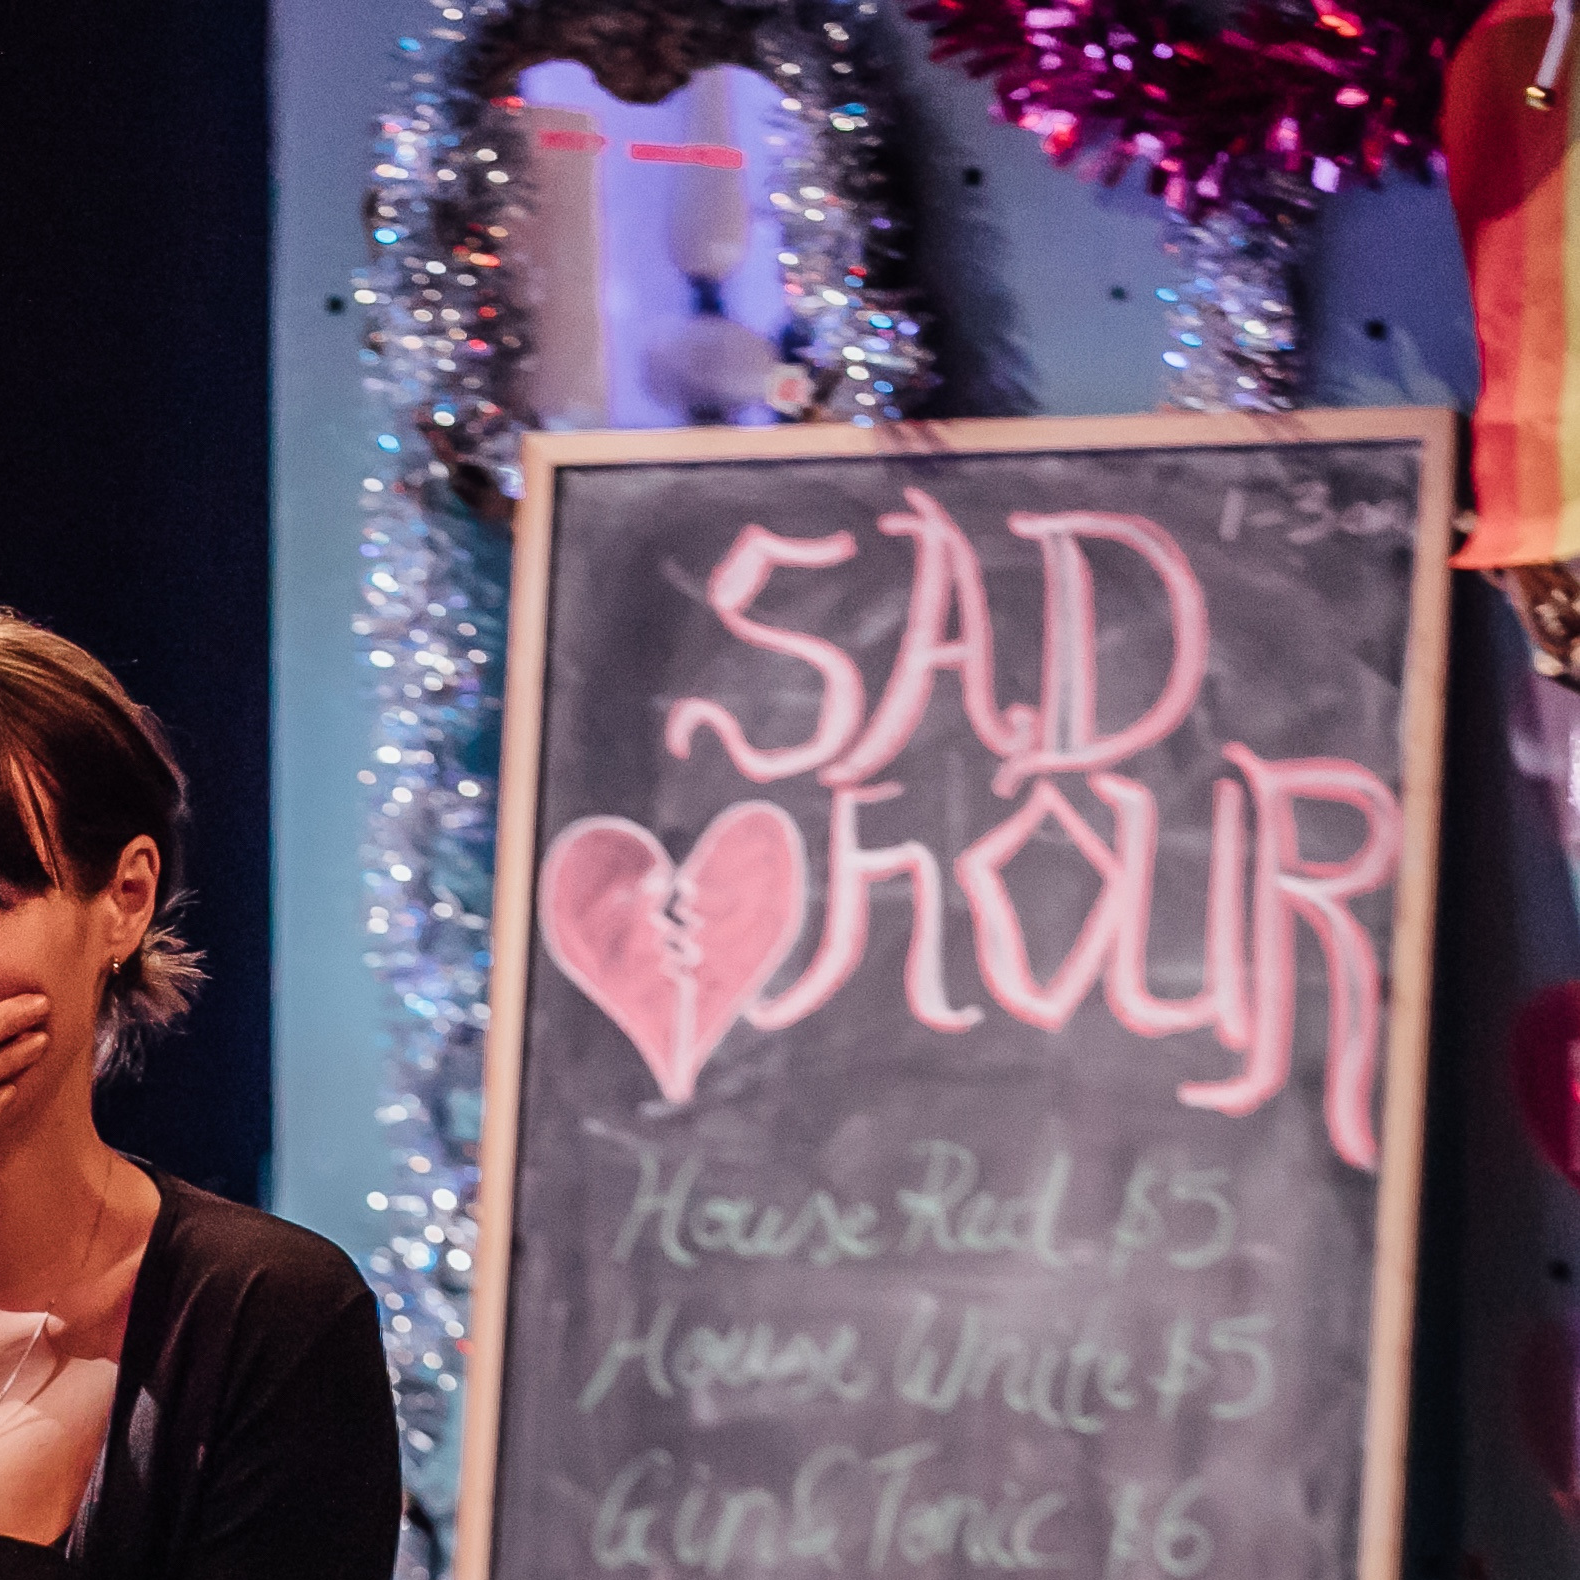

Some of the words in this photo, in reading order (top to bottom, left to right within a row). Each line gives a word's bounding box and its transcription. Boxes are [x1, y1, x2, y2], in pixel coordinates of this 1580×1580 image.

[666, 486, 1209, 800] SAD
[613, 1143, 881, 1268] House
[896, 1137, 1071, 1267] Red
[1109, 1162, 1238, 1275] $5
[579, 1303, 874, 1412] House
[894, 1297, 1135, 1434] White
[1149, 1315, 1276, 1420] $5
[869, 1439, 1074, 1571] Tonic
